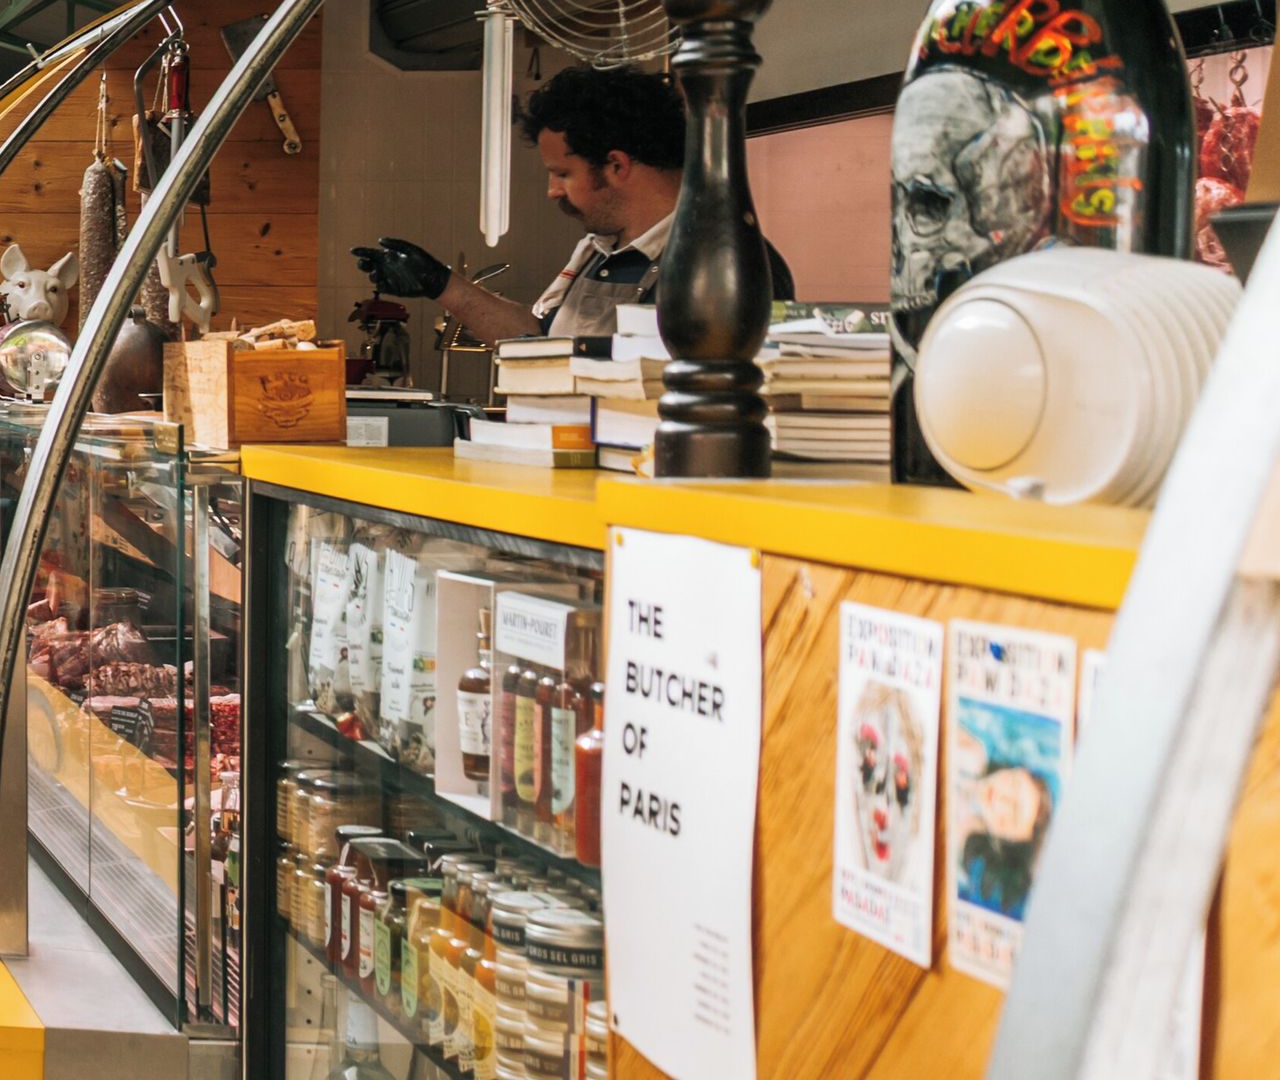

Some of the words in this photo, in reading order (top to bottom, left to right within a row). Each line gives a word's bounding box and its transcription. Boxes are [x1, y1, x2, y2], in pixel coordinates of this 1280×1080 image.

[627, 599, 664, 640] THE
[625, 660, 726, 723] BUTCHER
[621, 722, 649, 760] OF
[618, 781, 683, 838] PARIS
[550, 950, 569, 964] SEL
[571, 953, 598, 965] GRIS
